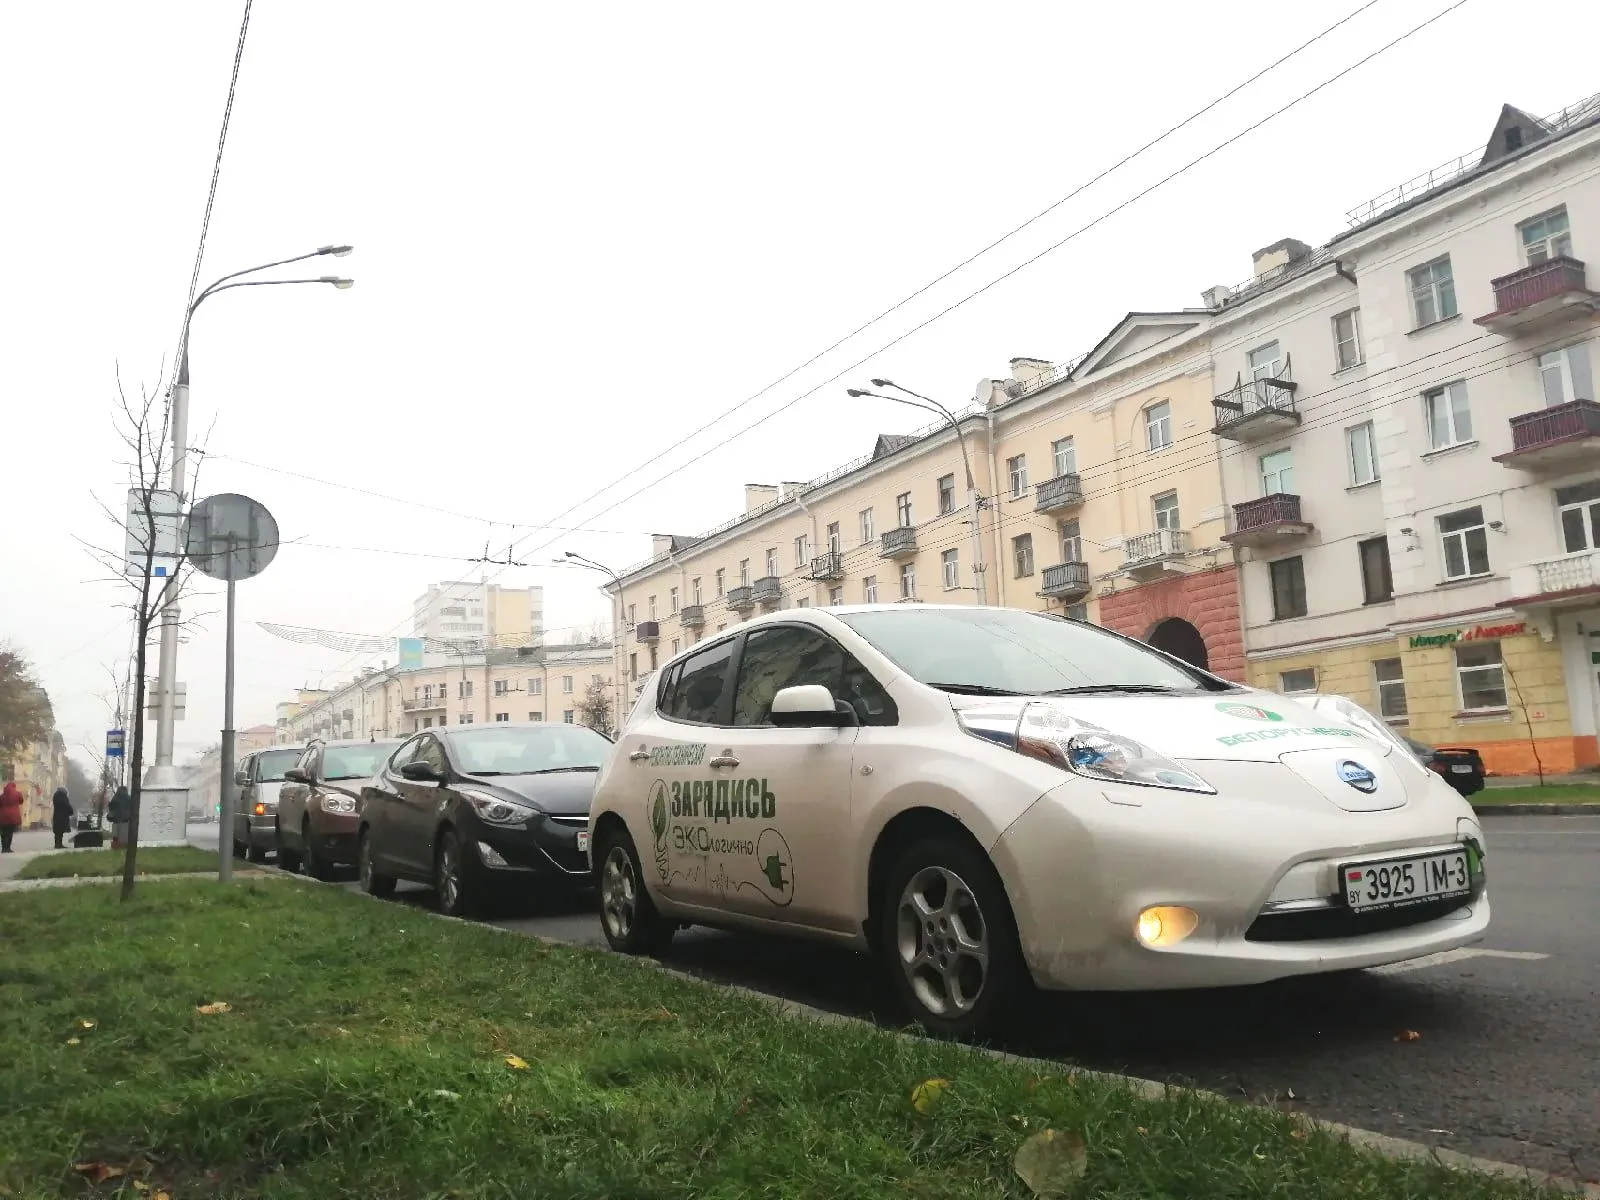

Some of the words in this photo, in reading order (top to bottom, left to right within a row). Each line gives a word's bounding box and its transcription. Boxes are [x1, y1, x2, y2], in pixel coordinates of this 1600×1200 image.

[671, 778, 776, 824] ЗАРЯДИСЬ
[672, 825, 754, 855] ЭКОлогично
[1366, 863, 1415, 900] 3925
[1424, 856, 1466, 892] IM-3
[1349, 890, 1361, 904] BY
